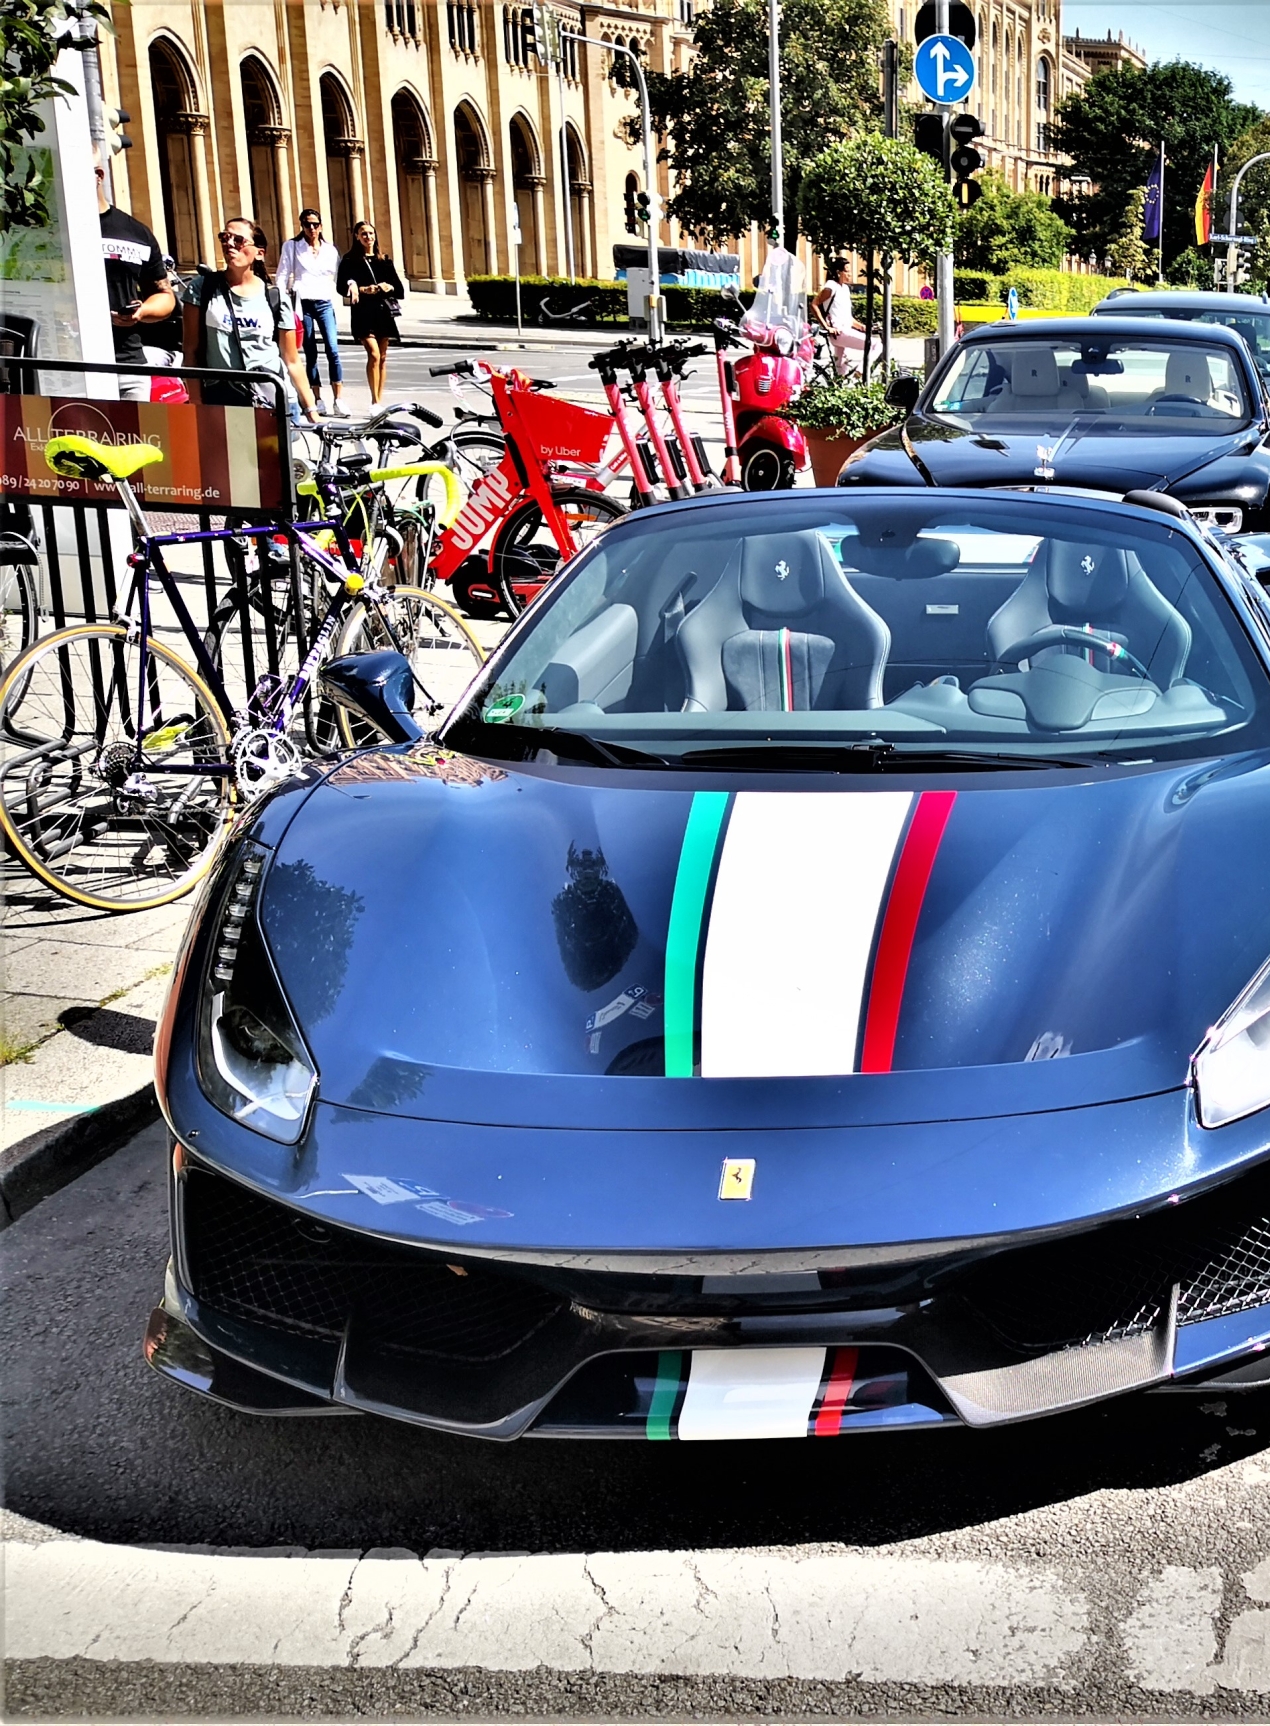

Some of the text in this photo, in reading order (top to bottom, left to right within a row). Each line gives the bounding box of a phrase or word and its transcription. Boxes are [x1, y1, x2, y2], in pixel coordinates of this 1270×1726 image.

[540, 445, 581, 456] by Uber
[451, 466, 513, 550] JUMP
